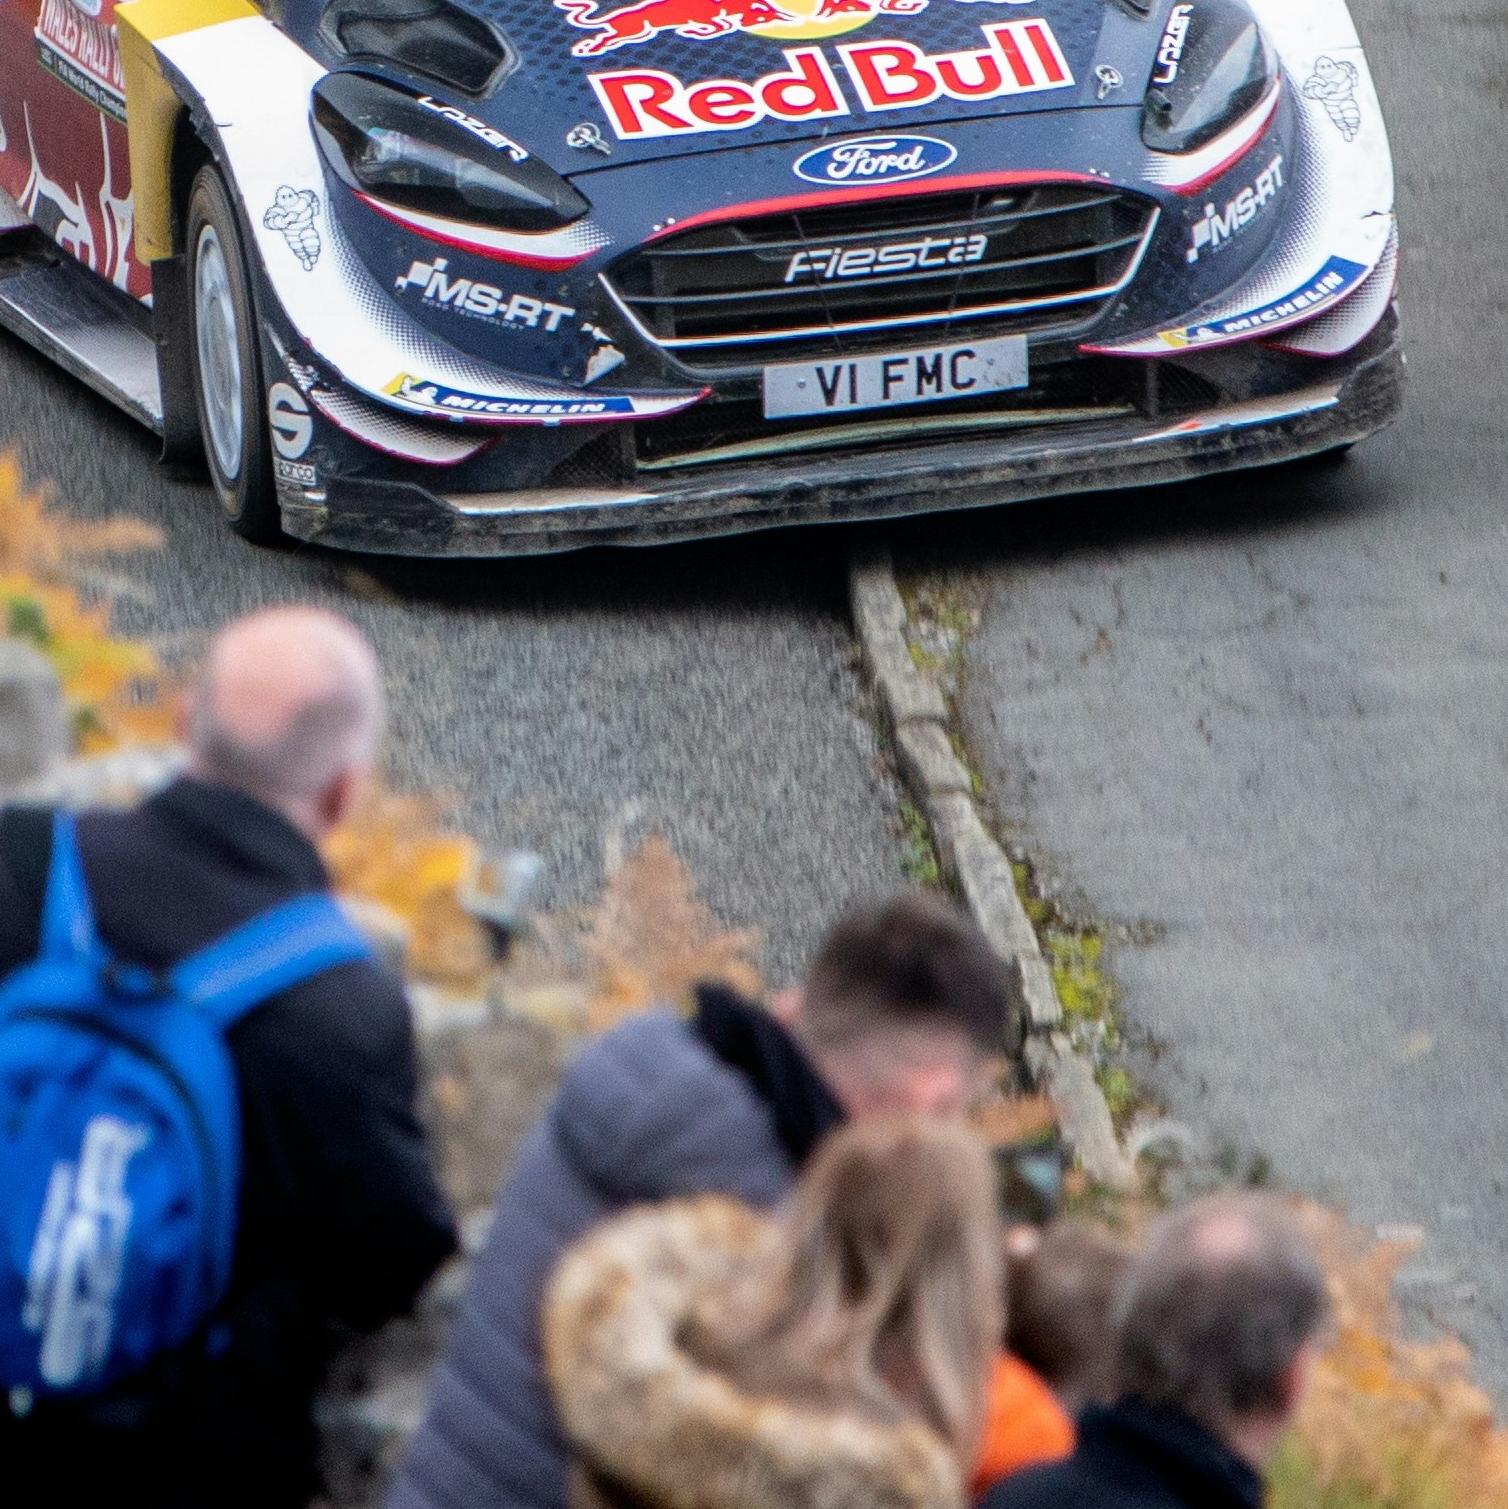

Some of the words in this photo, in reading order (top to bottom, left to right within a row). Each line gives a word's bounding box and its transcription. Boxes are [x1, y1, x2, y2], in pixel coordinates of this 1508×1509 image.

[598, 54, 835, 134] Red
[851, 24, 1065, 105] Bull
[828, 140, 927, 179] Ford
[785, 234, 989, 283] Fiesta
[1224, 271, 1344, 335] MICHELIN
[882, 348, 976, 400] FMC
[442, 395, 606, 415] MICHELIN
